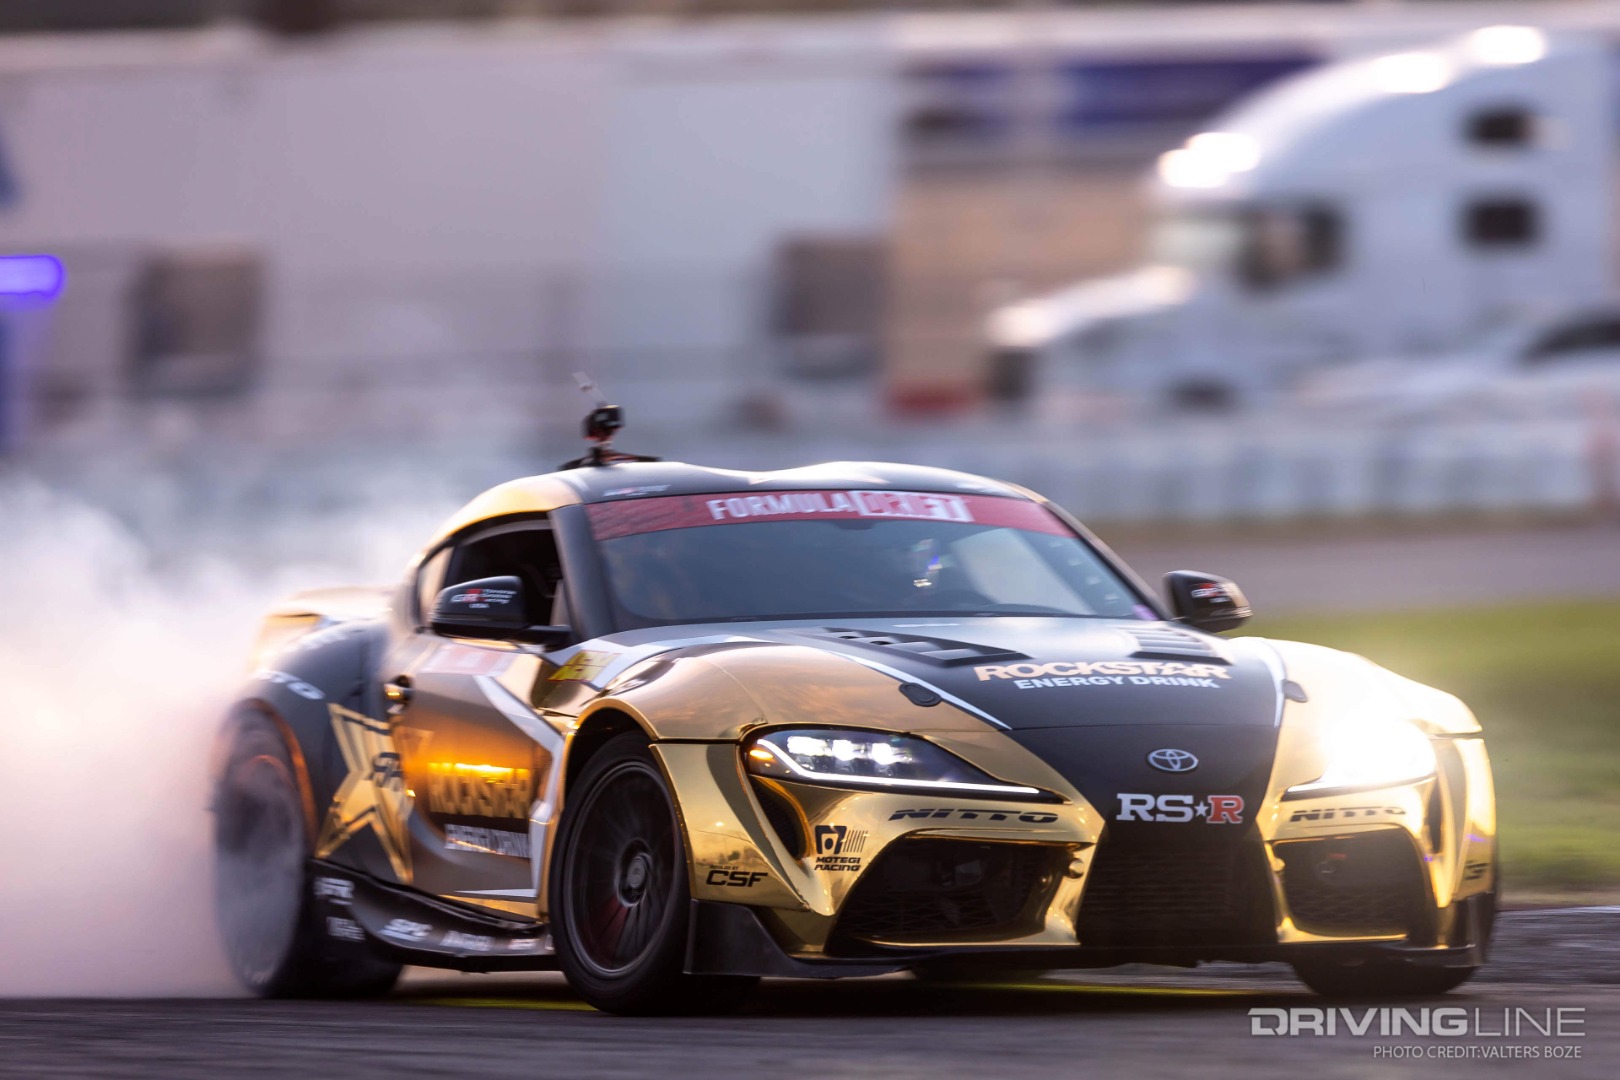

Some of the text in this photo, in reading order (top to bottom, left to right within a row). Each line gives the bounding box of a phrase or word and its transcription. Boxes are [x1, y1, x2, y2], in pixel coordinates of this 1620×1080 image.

[707, 492, 852, 520] FORMULA
[973, 661, 1232, 681] ROCKSTAR
[1014, 676, 1221, 690] ENERGY DRINK
[888, 808, 1058, 823] NITTO
[1289, 806, 1407, 822] NITTO
[815, 856, 861, 864] MOTEGI
[814, 864, 861, 872] RACING
[706, 869, 768, 888] CSF
